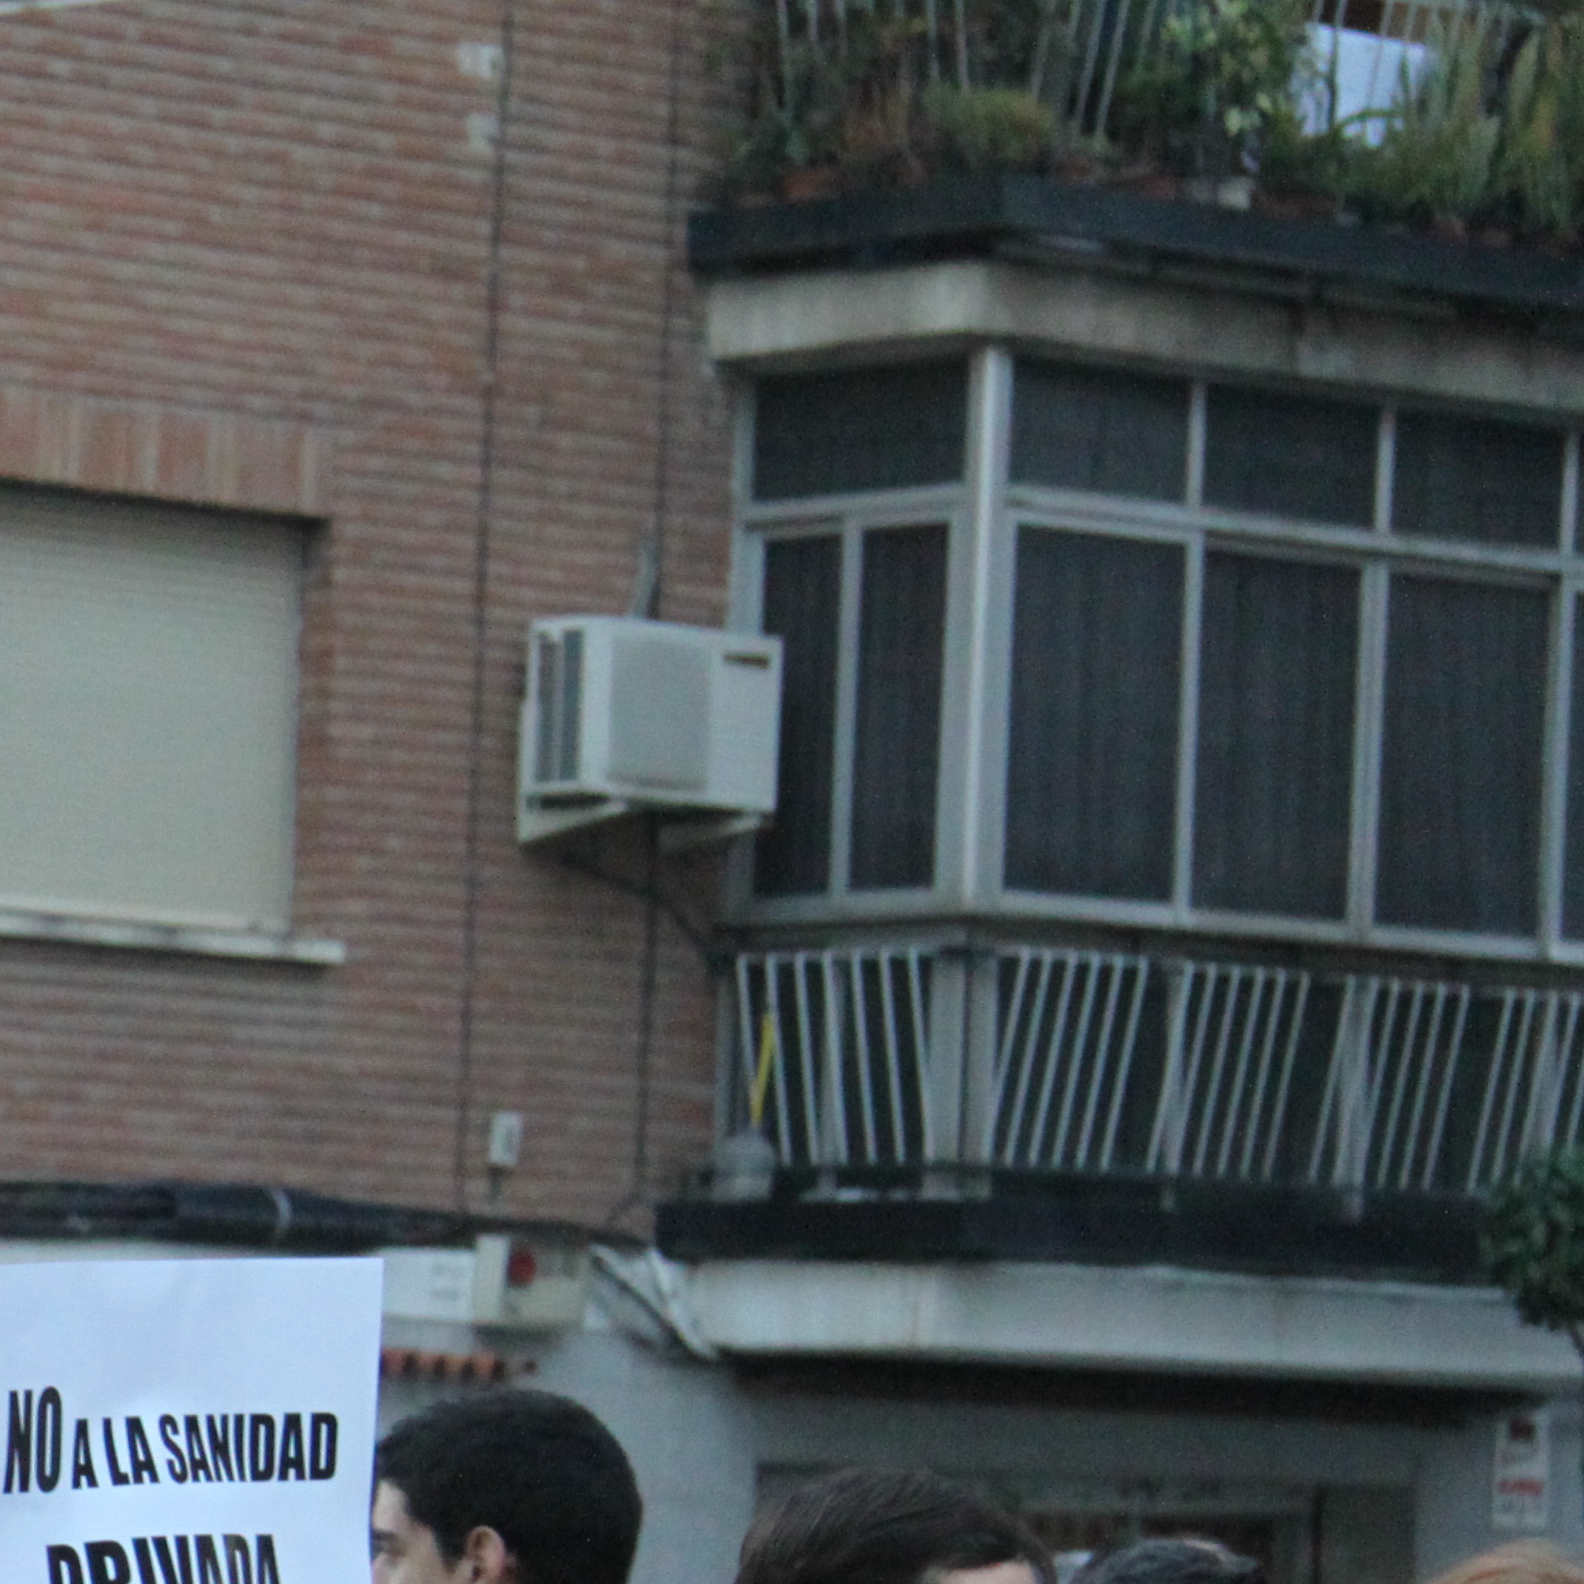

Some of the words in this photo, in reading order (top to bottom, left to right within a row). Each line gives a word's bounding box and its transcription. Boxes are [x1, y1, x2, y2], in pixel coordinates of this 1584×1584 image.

[3, 1386, 62, 1494] NO
[71, 1418, 99, 1490] A
[103, 1416, 158, 1486] LA
[160, 1412, 340, 1484] SANIDAD
